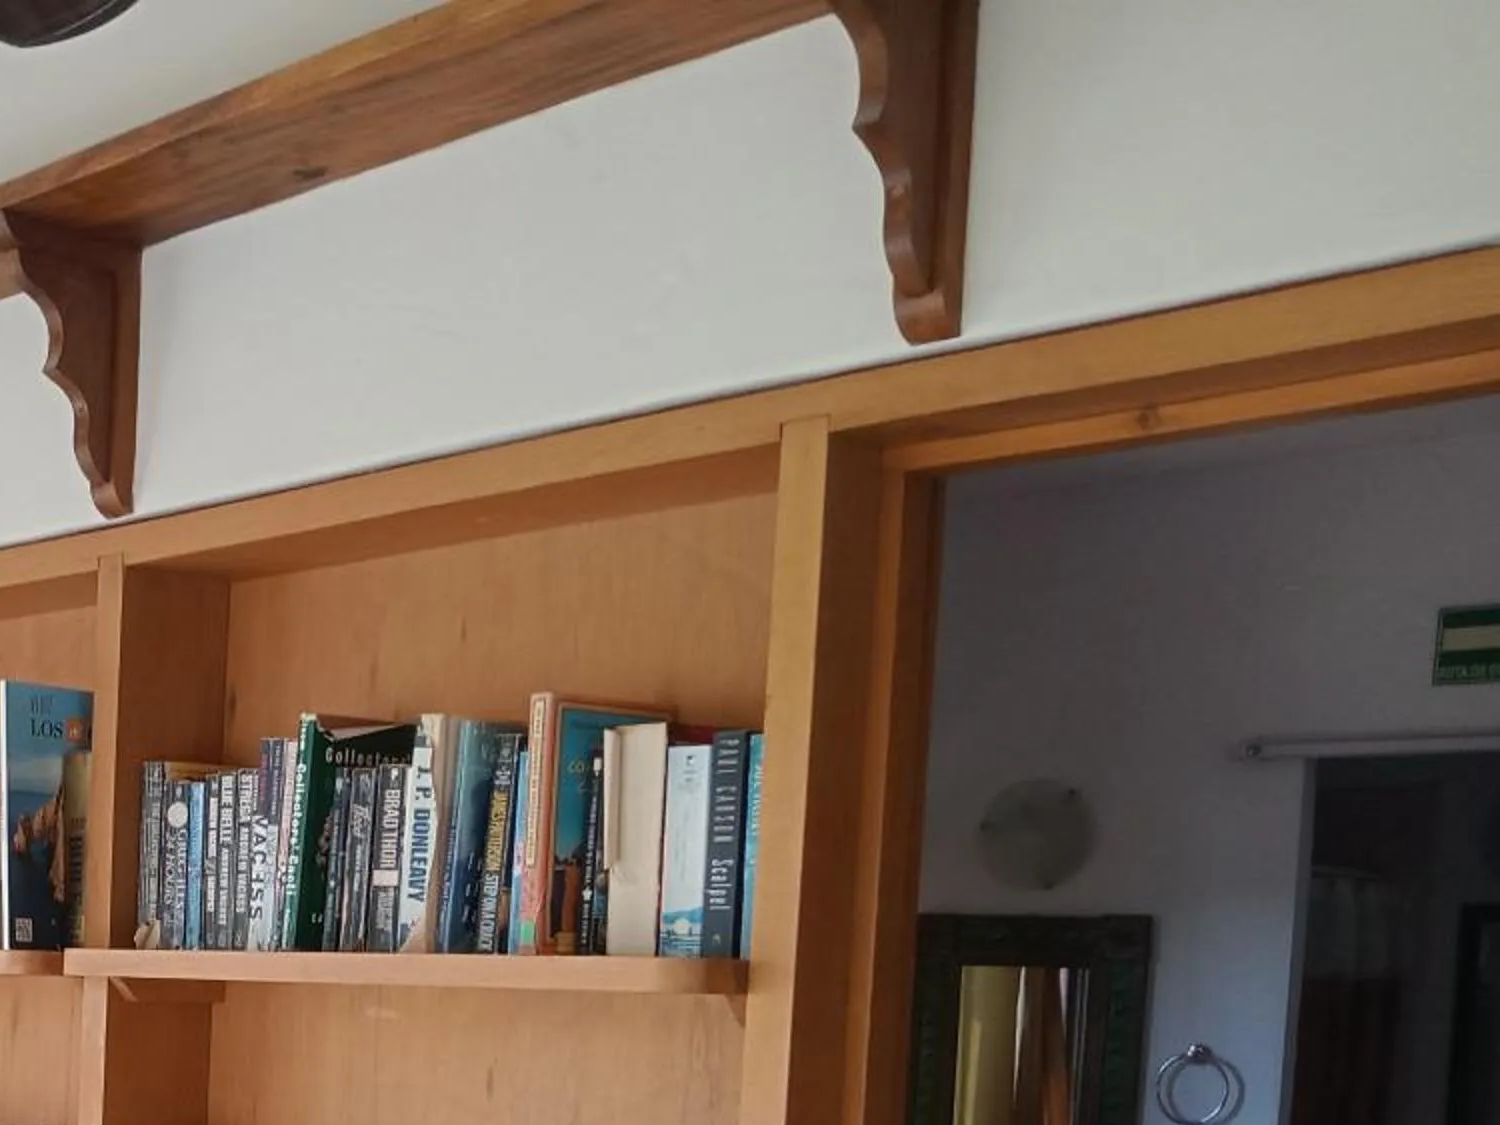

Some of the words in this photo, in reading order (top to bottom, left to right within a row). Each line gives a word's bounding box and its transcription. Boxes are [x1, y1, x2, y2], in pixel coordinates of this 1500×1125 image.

[384, 789, 401, 828] BRAD
[414, 787, 432, 801] P.
[379, 829, 398, 868] THOR
[408, 808, 431, 903] DONLEAVY
[705, 859, 734, 911] Scalpel
